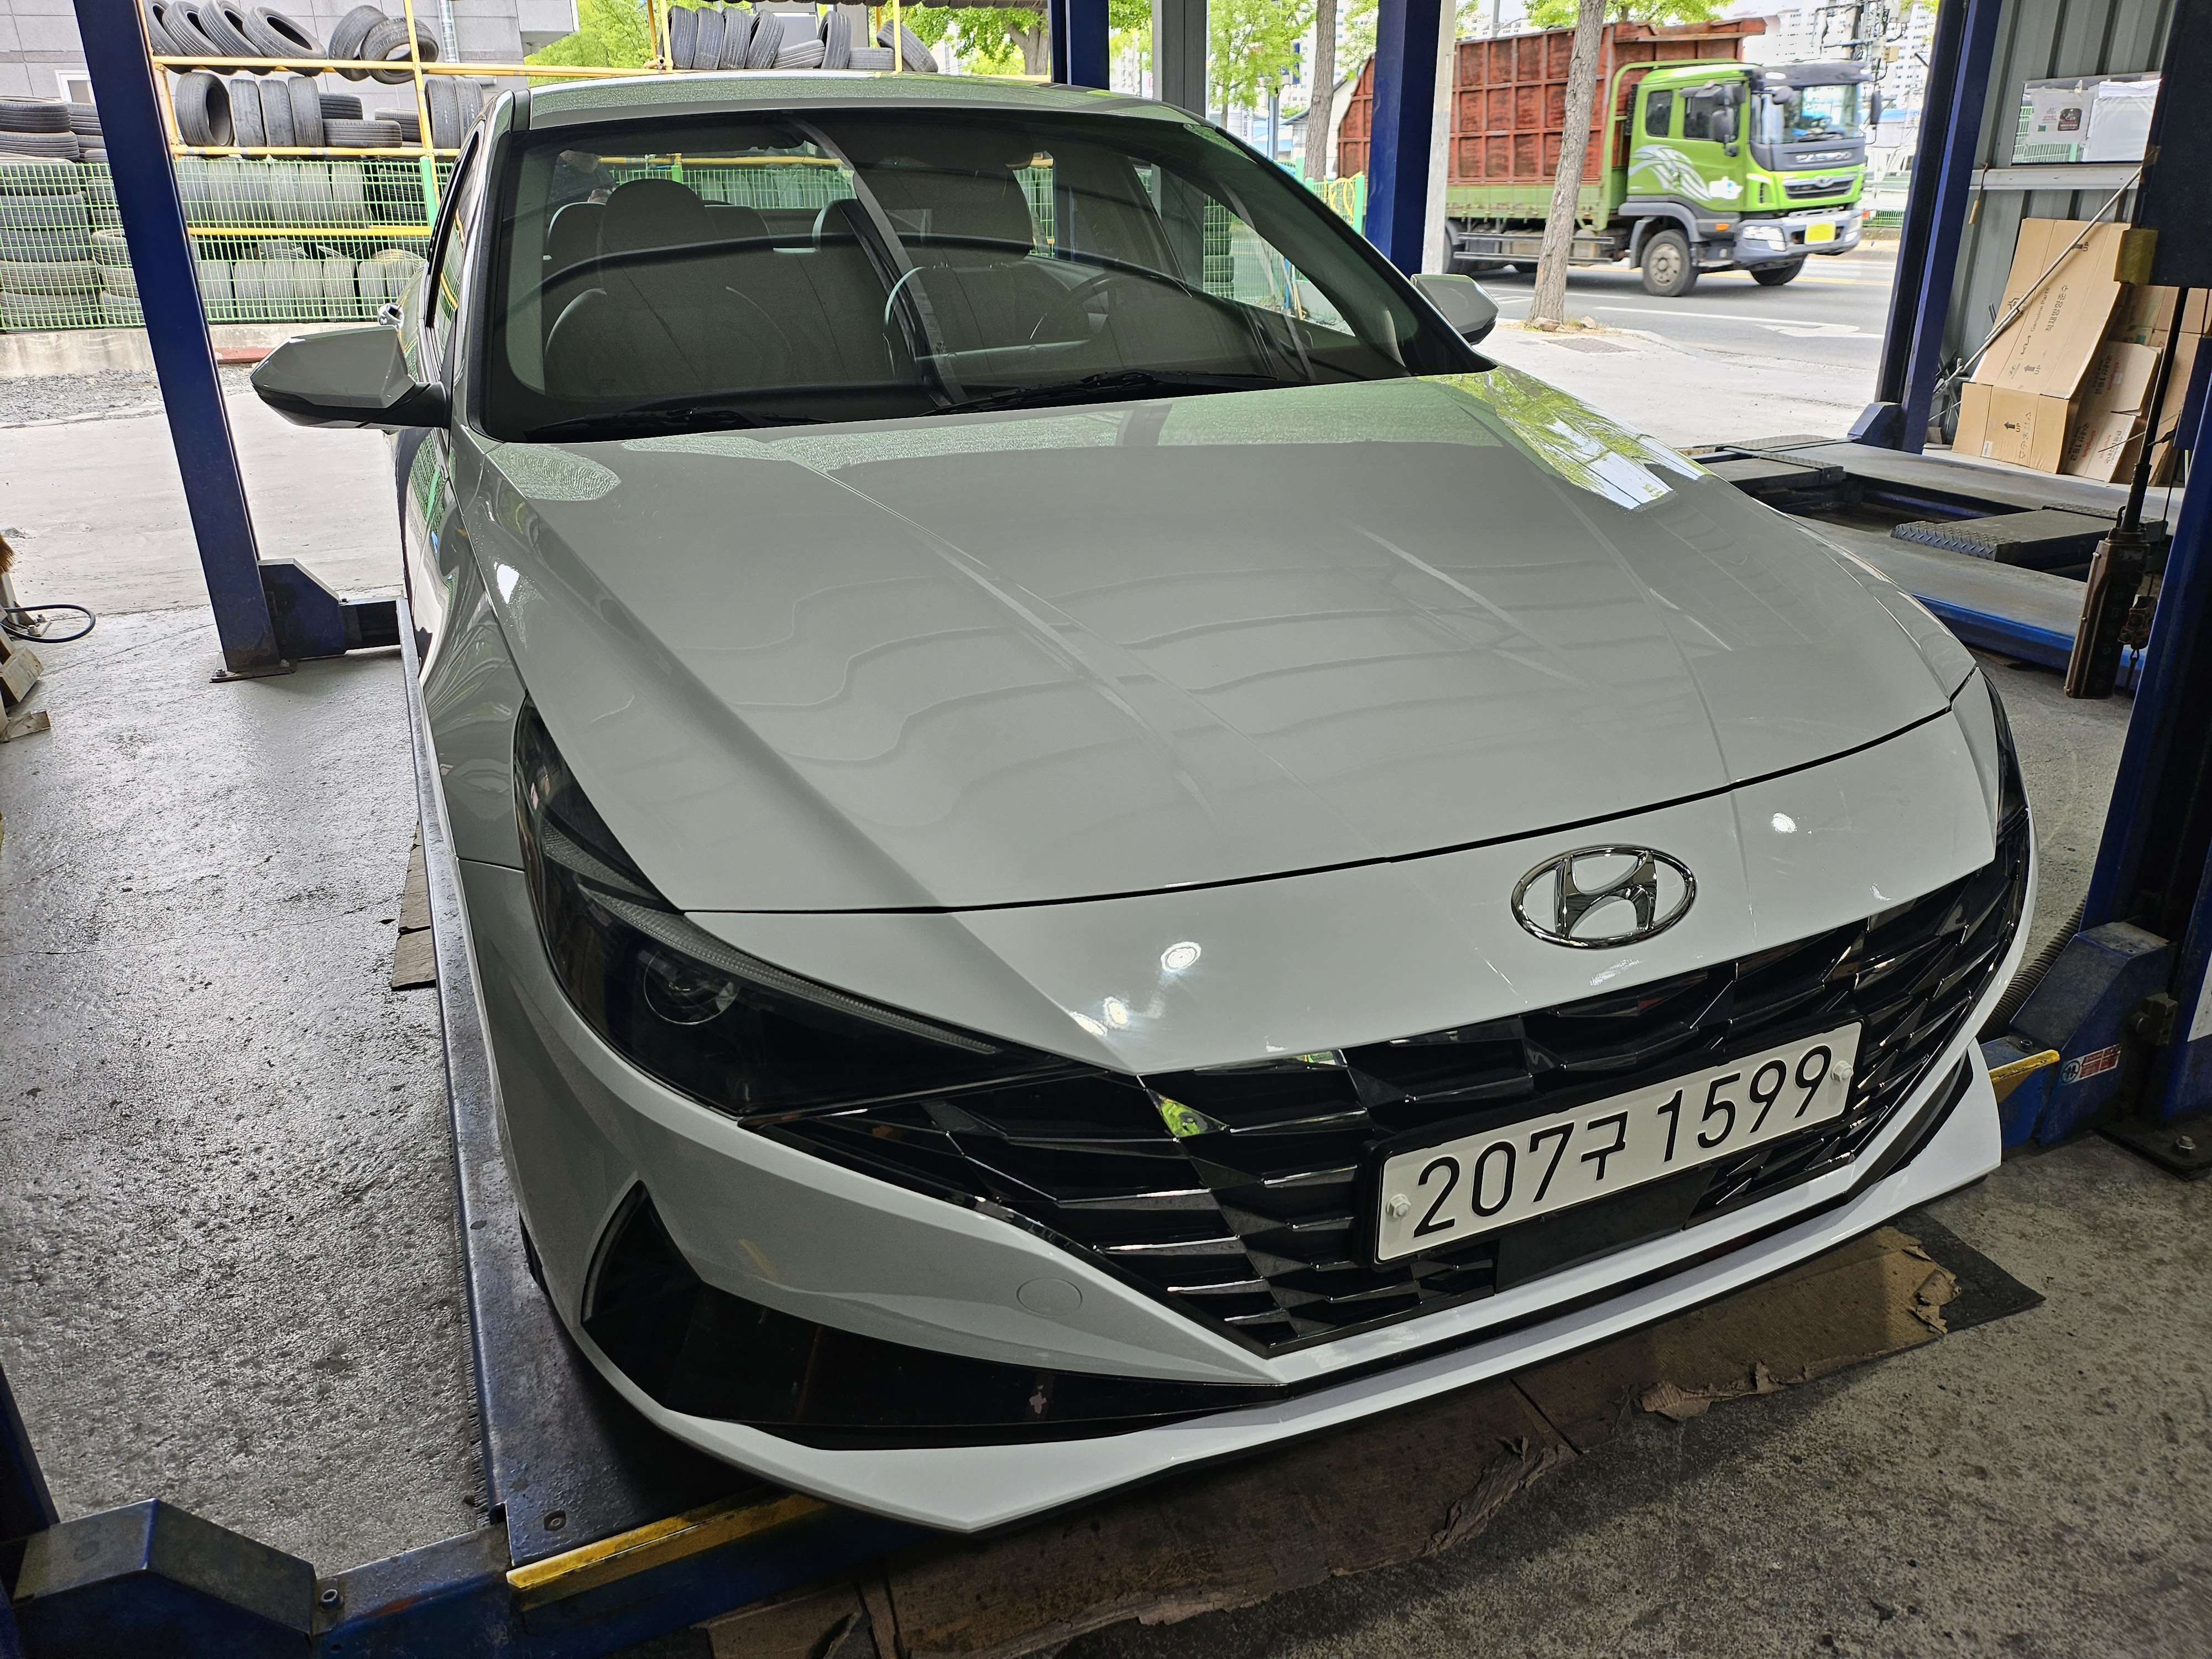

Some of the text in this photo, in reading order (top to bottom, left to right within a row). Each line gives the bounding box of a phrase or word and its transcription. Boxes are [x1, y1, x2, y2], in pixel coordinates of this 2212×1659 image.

[2083, 242, 2089, 252] UP
[2031, 306, 2044, 332] Genuine
[2040, 288, 2050, 305] Parts
[2045, 284, 2068, 332] 적재방향준수
[2034, 364, 2041, 374] UP
[2016, 422, 2021, 432] UP
[2082, 430, 2096, 458] simplus
[1412, 1044, 1832, 1238] 207구 1599
